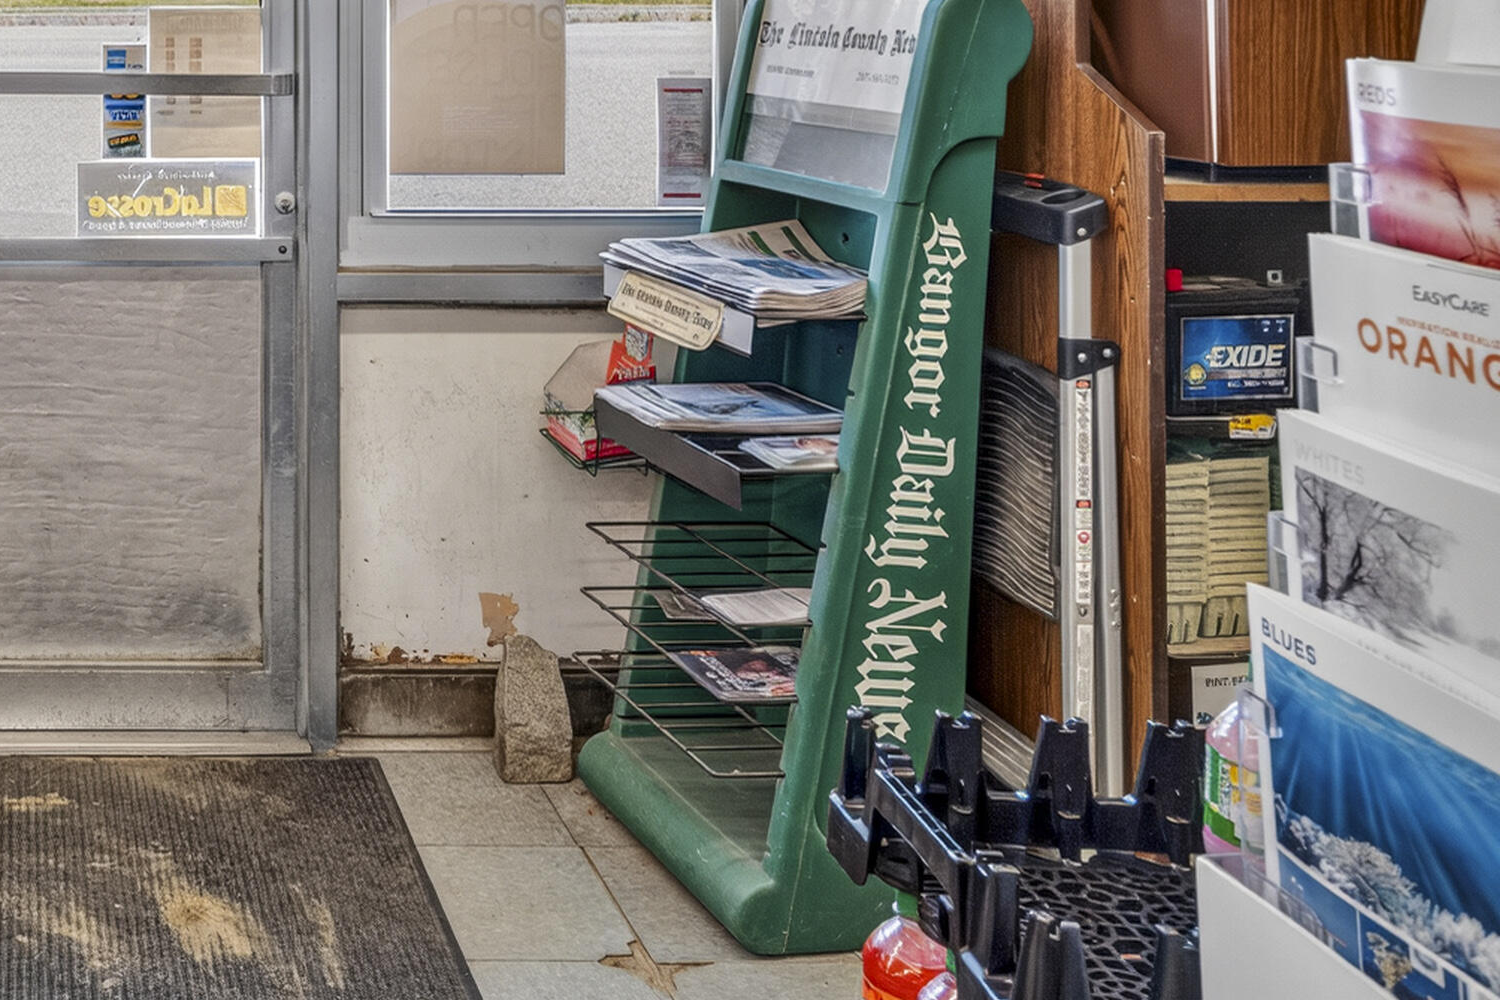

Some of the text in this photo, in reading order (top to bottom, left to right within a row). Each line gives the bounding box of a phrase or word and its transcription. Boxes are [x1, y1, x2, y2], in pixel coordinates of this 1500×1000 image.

[1357, 83, 1396, 106] REDS
[903, 212, 967, 419] Bangor
[1412, 285, 1490, 317] EASYCARE
[1205, 344, 1286, 368] EXIDE
[1296, 441, 1365, 485] WHITES
[864, 425, 957, 570] Daily
[1262, 617, 1317, 666] BLUES
